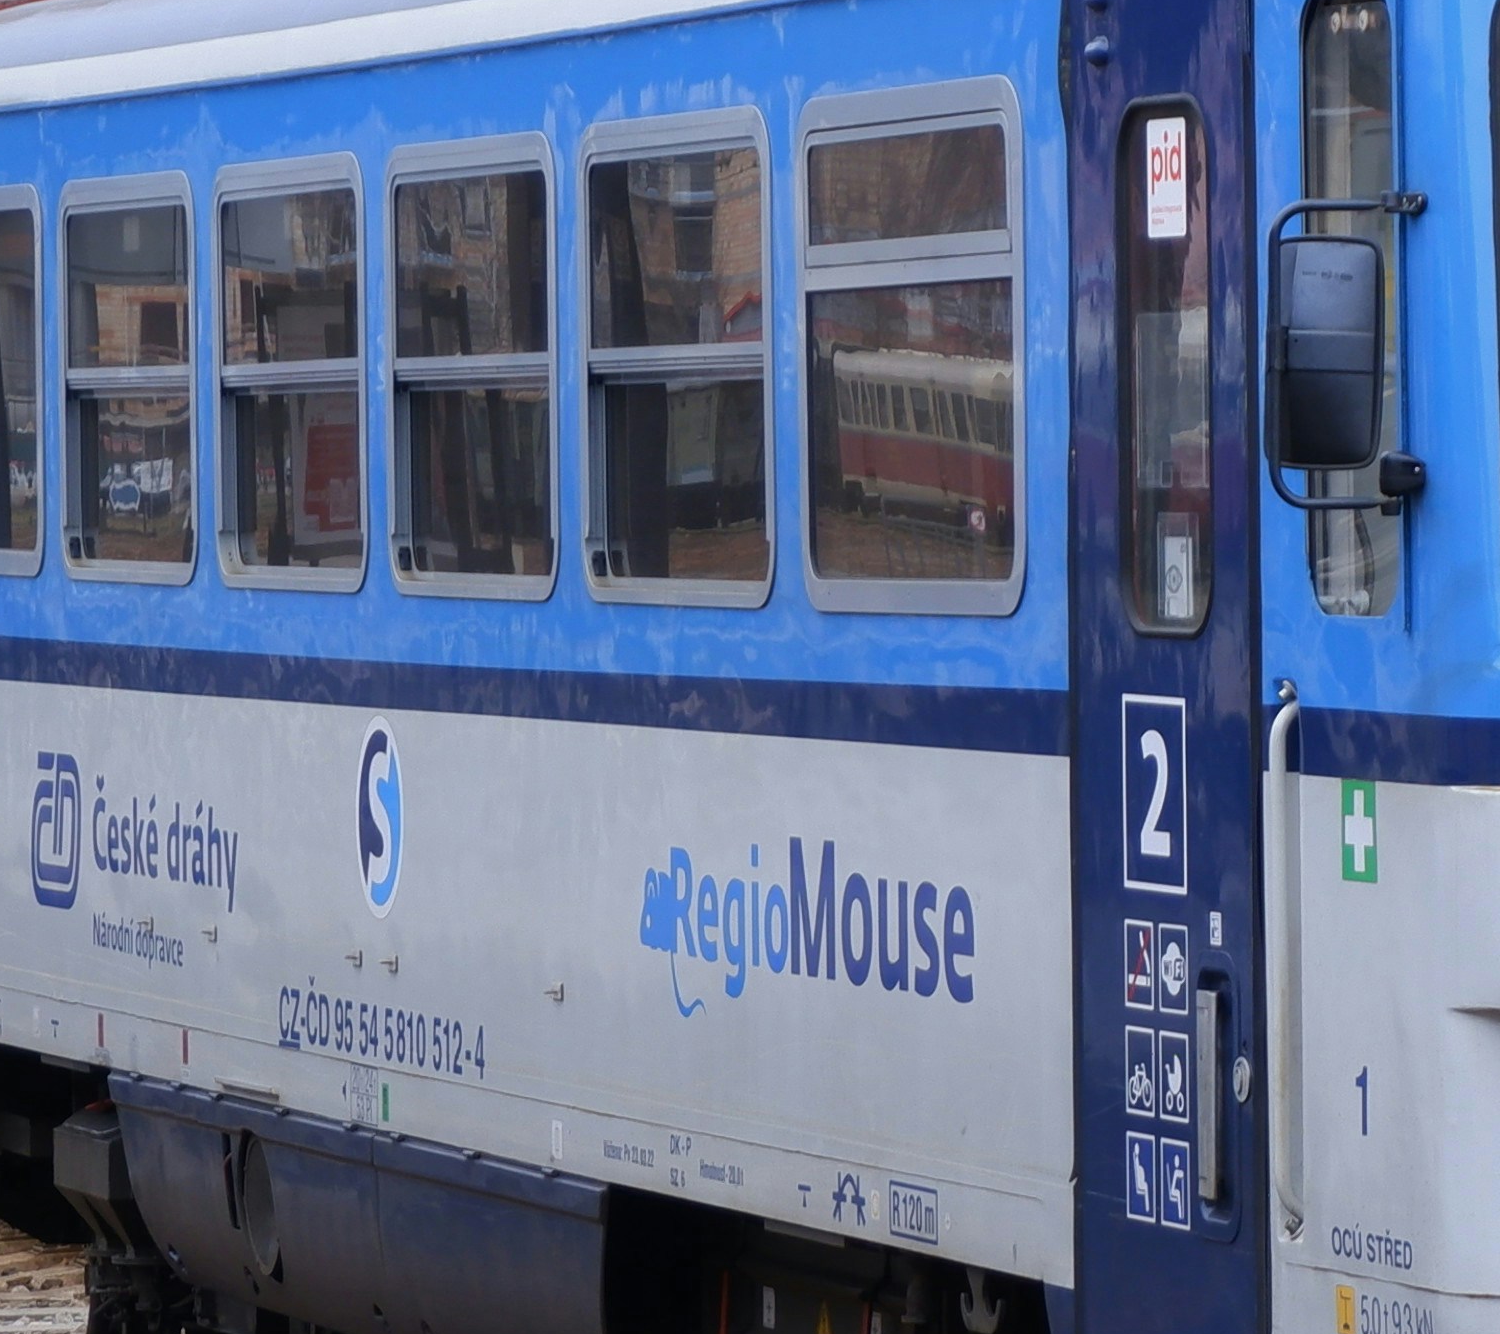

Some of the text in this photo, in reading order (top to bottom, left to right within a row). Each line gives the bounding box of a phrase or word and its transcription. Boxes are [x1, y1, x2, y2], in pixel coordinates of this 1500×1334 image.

[1151, 130, 1182, 196] pid
[1139, 729, 1171, 857] 2
[92, 774, 238, 913] České dráhy
[92, 911, 184, 969] Národní dopravce
[670, 836, 975, 1003] RegioMouse
[278, 975, 330, 1049] CZ-ČD
[334, 998, 354, 1053] 95
[359, 1003, 378, 1057] 54
[1354, 1066, 1368, 1137] 1
[892, 1190, 935, 1235] R 120 m
[1331, 1223, 1413, 1270] OCÚ STŘED
